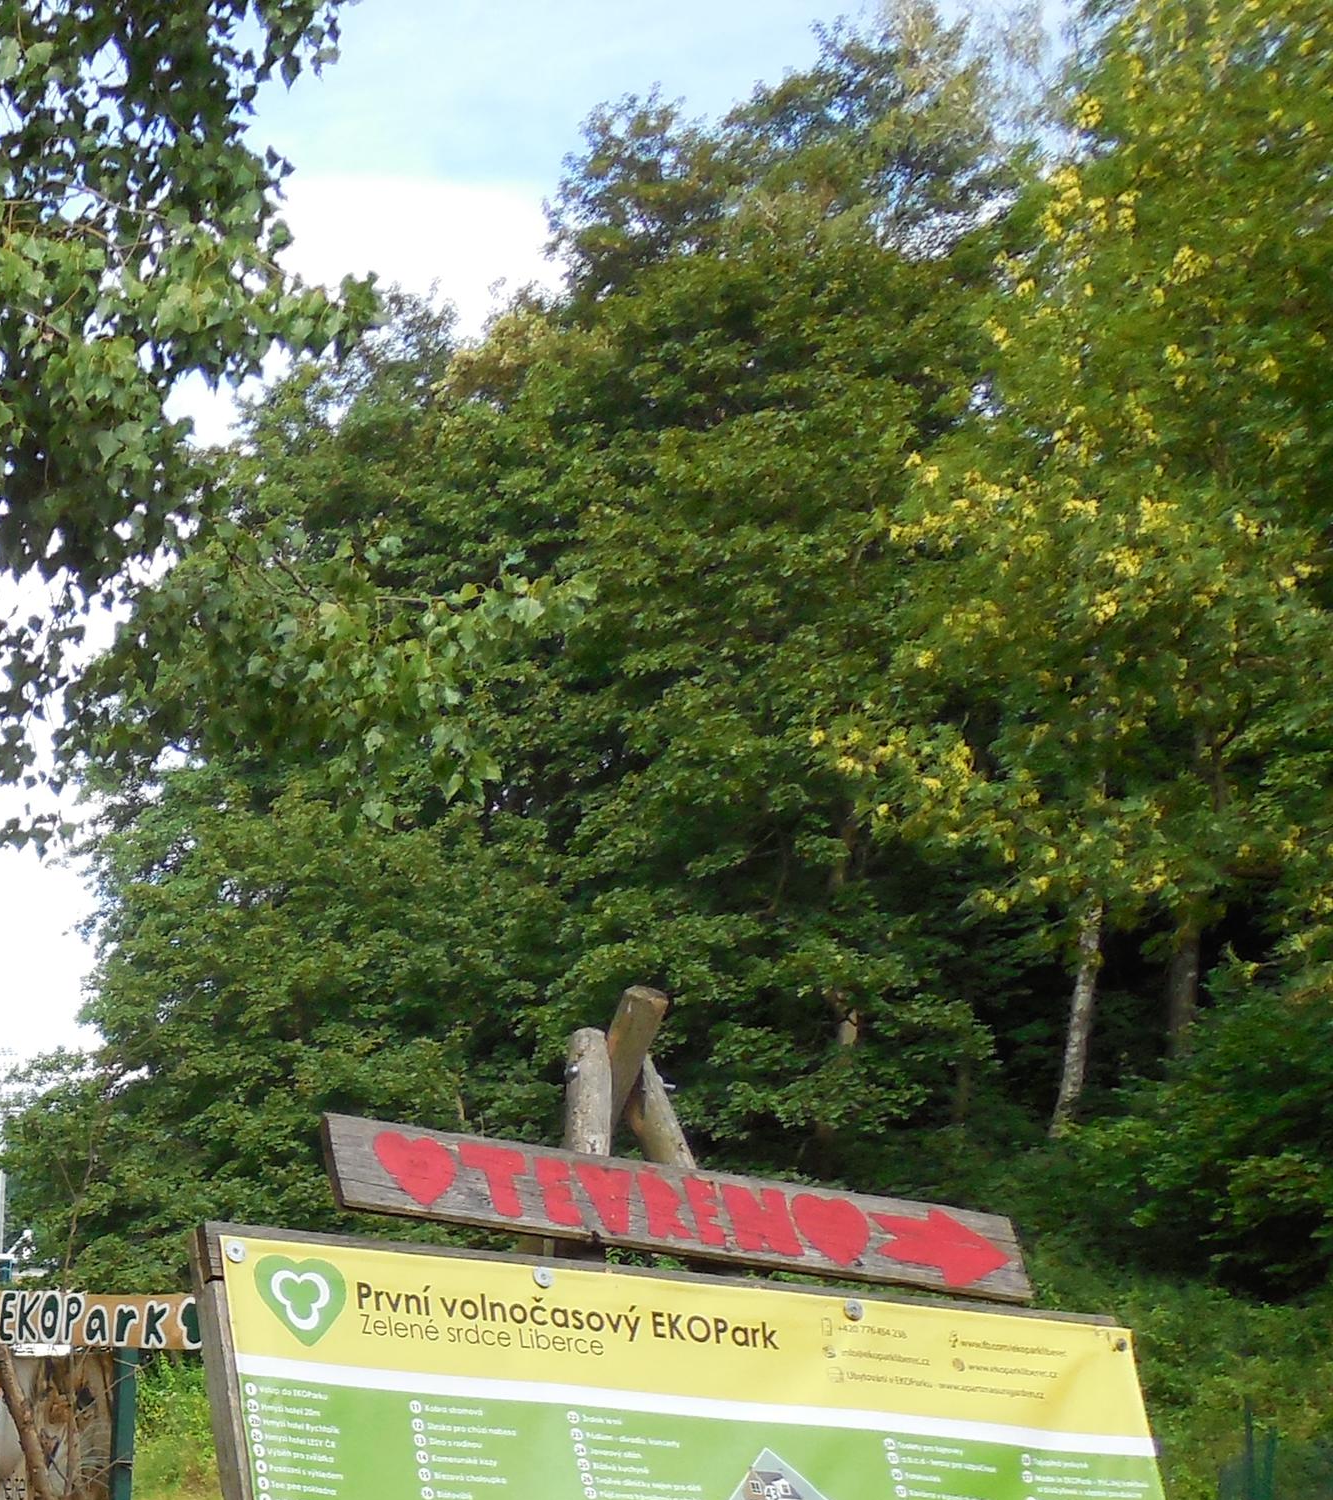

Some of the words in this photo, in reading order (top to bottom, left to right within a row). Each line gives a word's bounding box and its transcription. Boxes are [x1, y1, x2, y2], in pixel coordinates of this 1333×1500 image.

[356, 1282, 431, 1317] První
[443, 1297, 641, 1341] volnočasový
[652, 1310, 780, 1350] EKOPark
[361, 1314, 440, 1340] Zelené
[447, 1324, 511, 1347] srdce
[519, 1328, 604, 1356] Liberce
